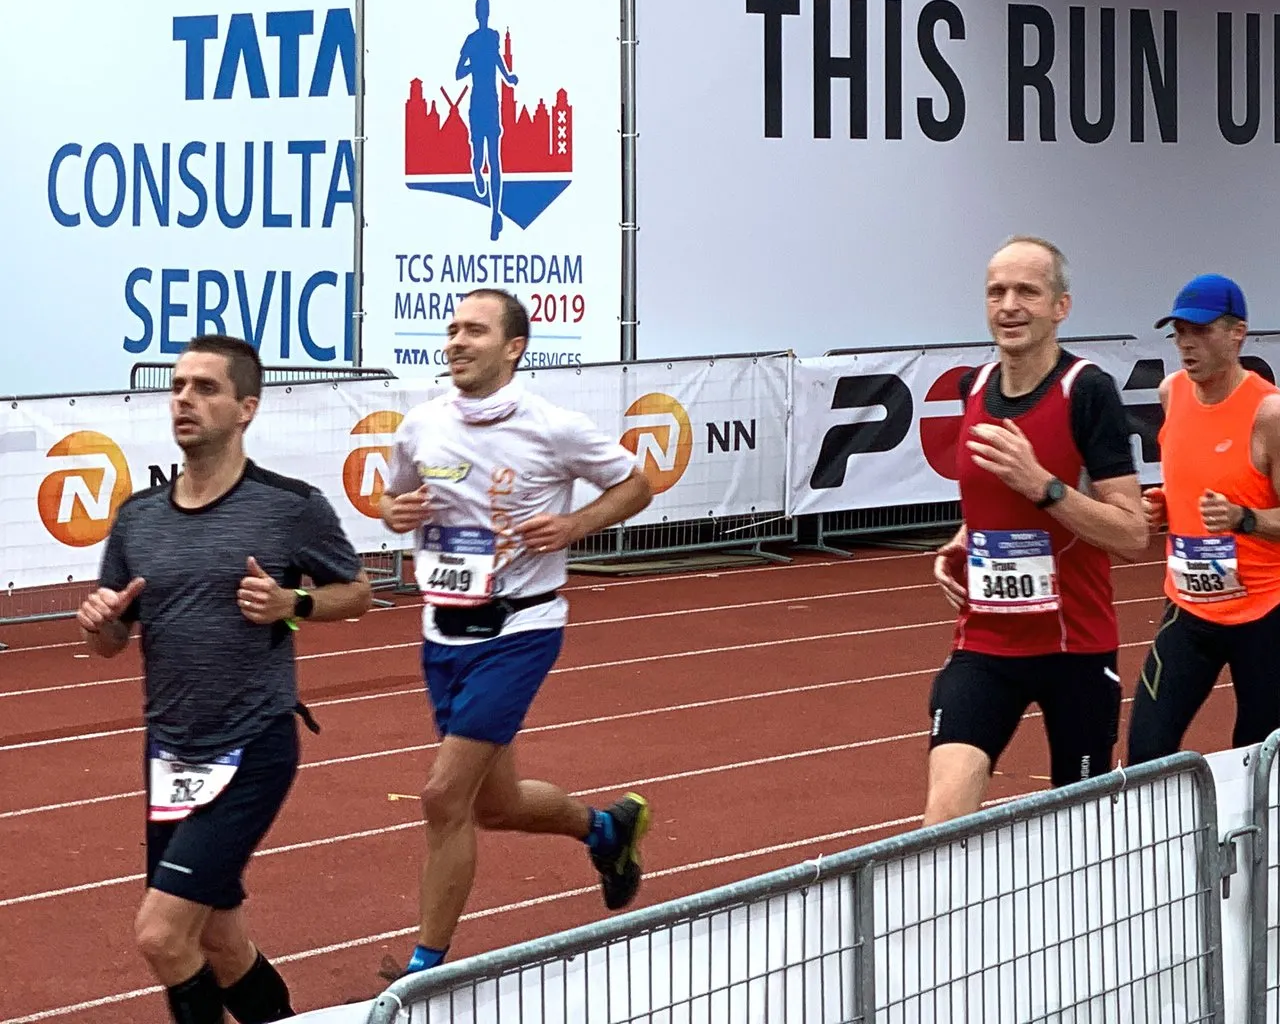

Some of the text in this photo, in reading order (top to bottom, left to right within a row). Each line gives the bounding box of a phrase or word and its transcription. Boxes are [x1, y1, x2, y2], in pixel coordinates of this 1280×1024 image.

[173, 8, 356, 100] TATA
[1006, 3, 1178, 144] RUN
[395, 254, 583, 283] TCS AMSTERDAM
[530, 294, 585, 323] 2019
[394, 349, 429, 365] TATA
[524, 352, 582, 368] SERVICES
[706, 419, 756, 453] NN
[427, 567, 472, 592] 4409
[982, 574, 1034, 598] 3480
